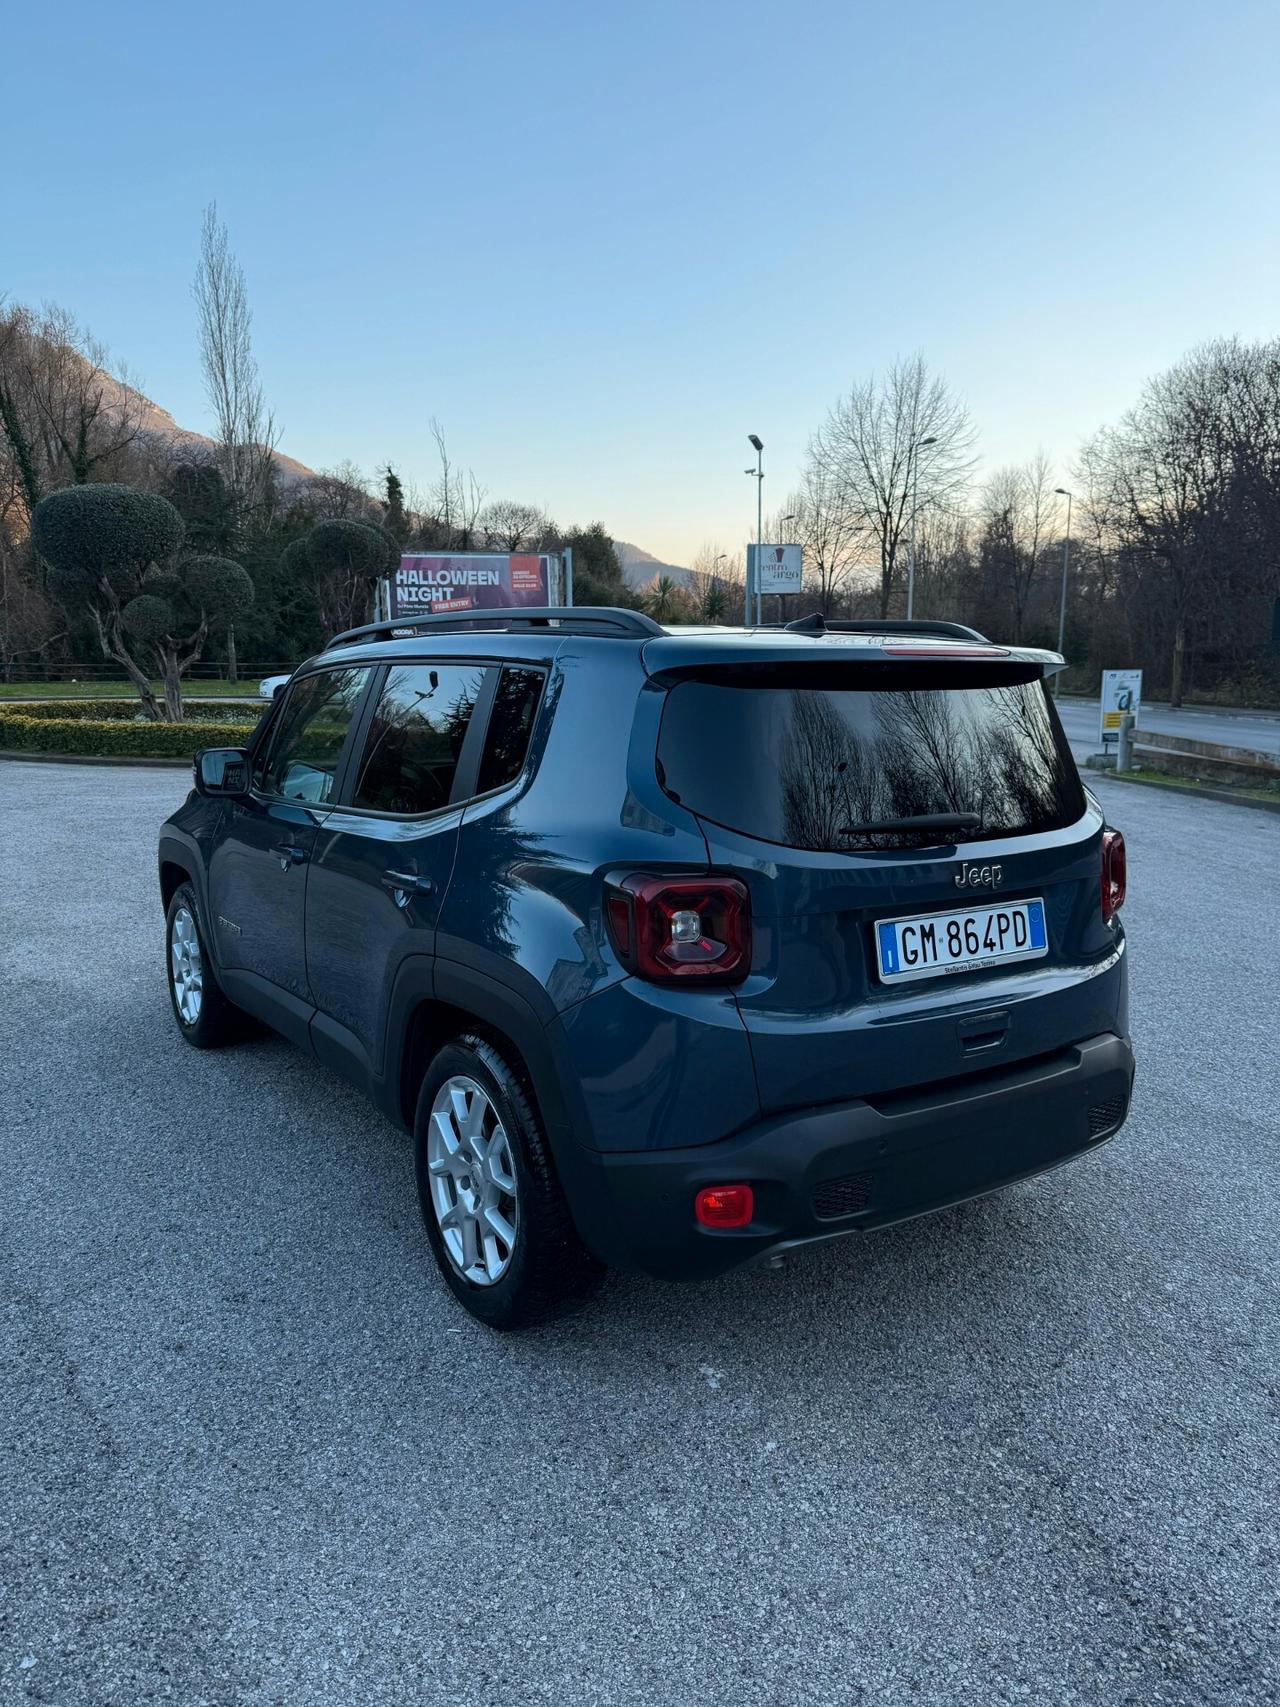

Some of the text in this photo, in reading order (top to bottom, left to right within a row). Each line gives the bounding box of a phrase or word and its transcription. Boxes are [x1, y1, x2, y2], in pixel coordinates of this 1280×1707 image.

[758, 564, 788, 572] entro
[396, 569, 500, 586] HALLOWEEN
[396, 587, 455, 602] NIGHT
[449, 599, 469, 608] ENTRY
[955, 862, 1002, 889] Jeep
[901, 910, 1027, 965] GM 864PD
[944, 964, 968, 974] Stellantis
